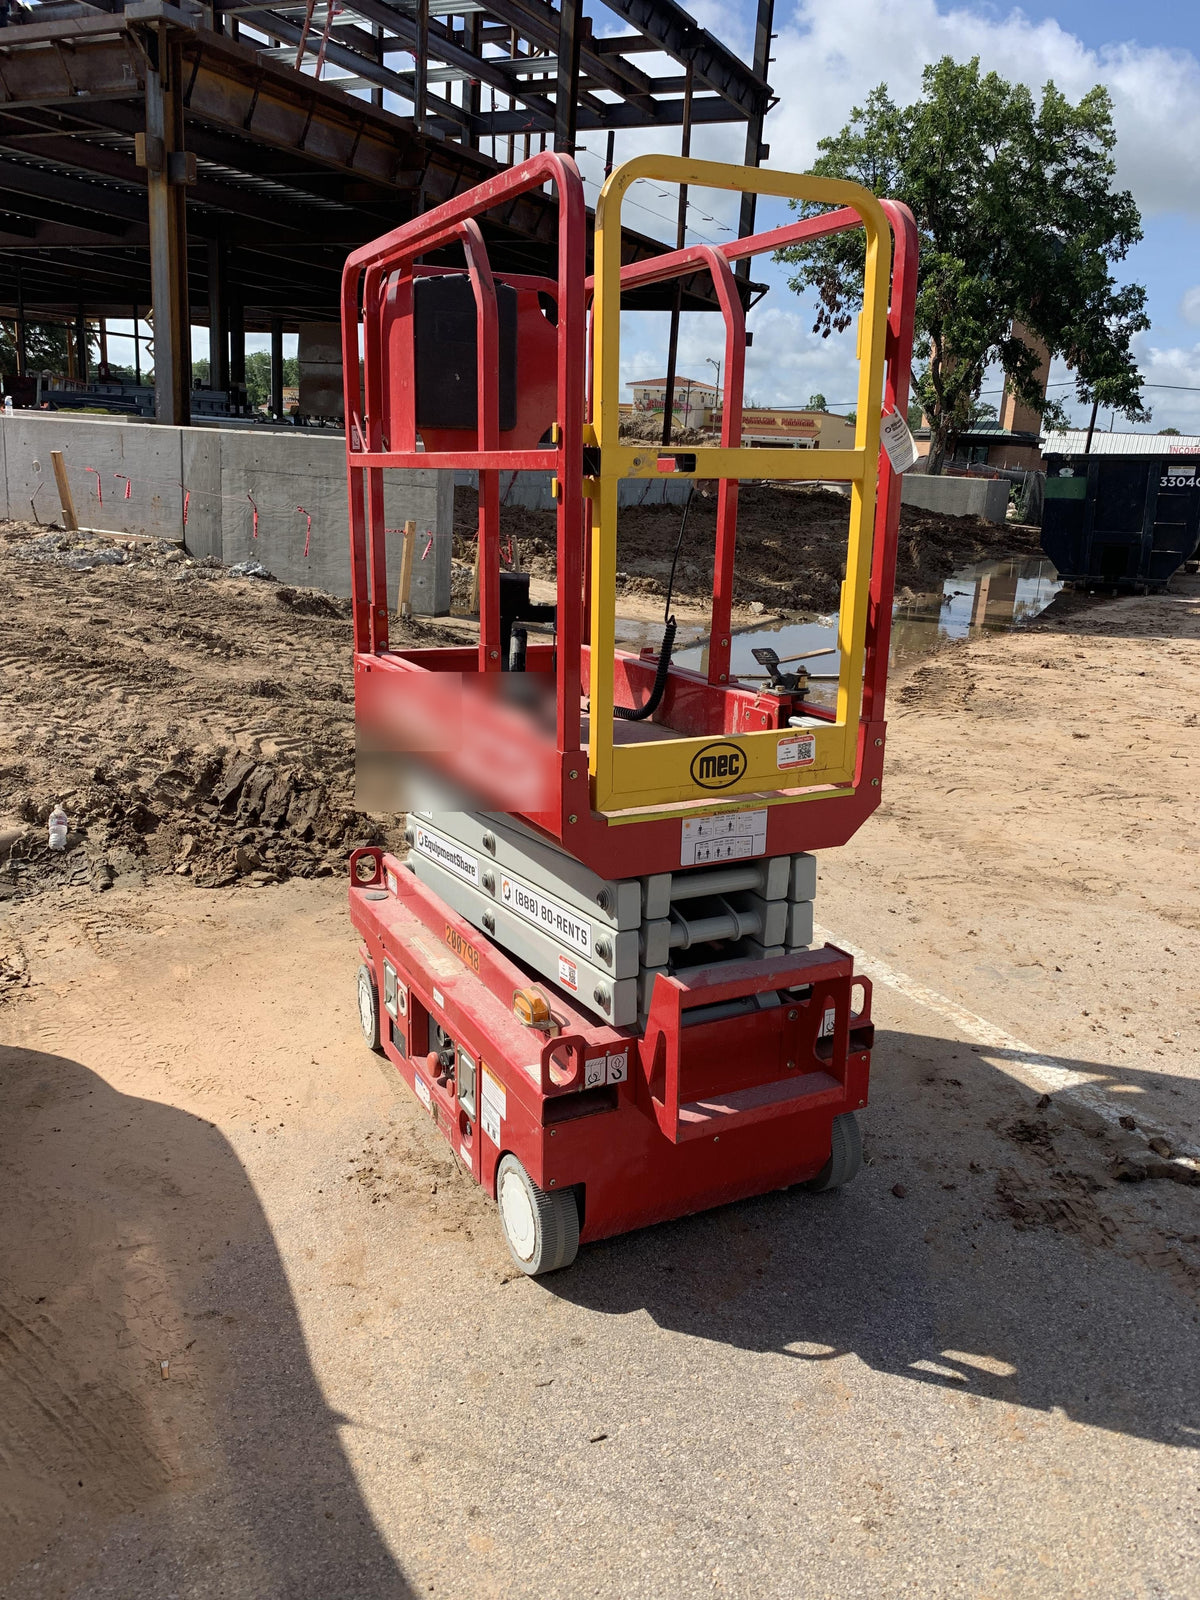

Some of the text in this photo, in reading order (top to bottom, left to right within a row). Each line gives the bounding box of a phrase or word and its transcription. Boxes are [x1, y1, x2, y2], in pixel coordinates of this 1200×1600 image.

[424, 834, 476, 877] EquipmentShare
[515, 888, 588, 946] (888) 80-RENTS
